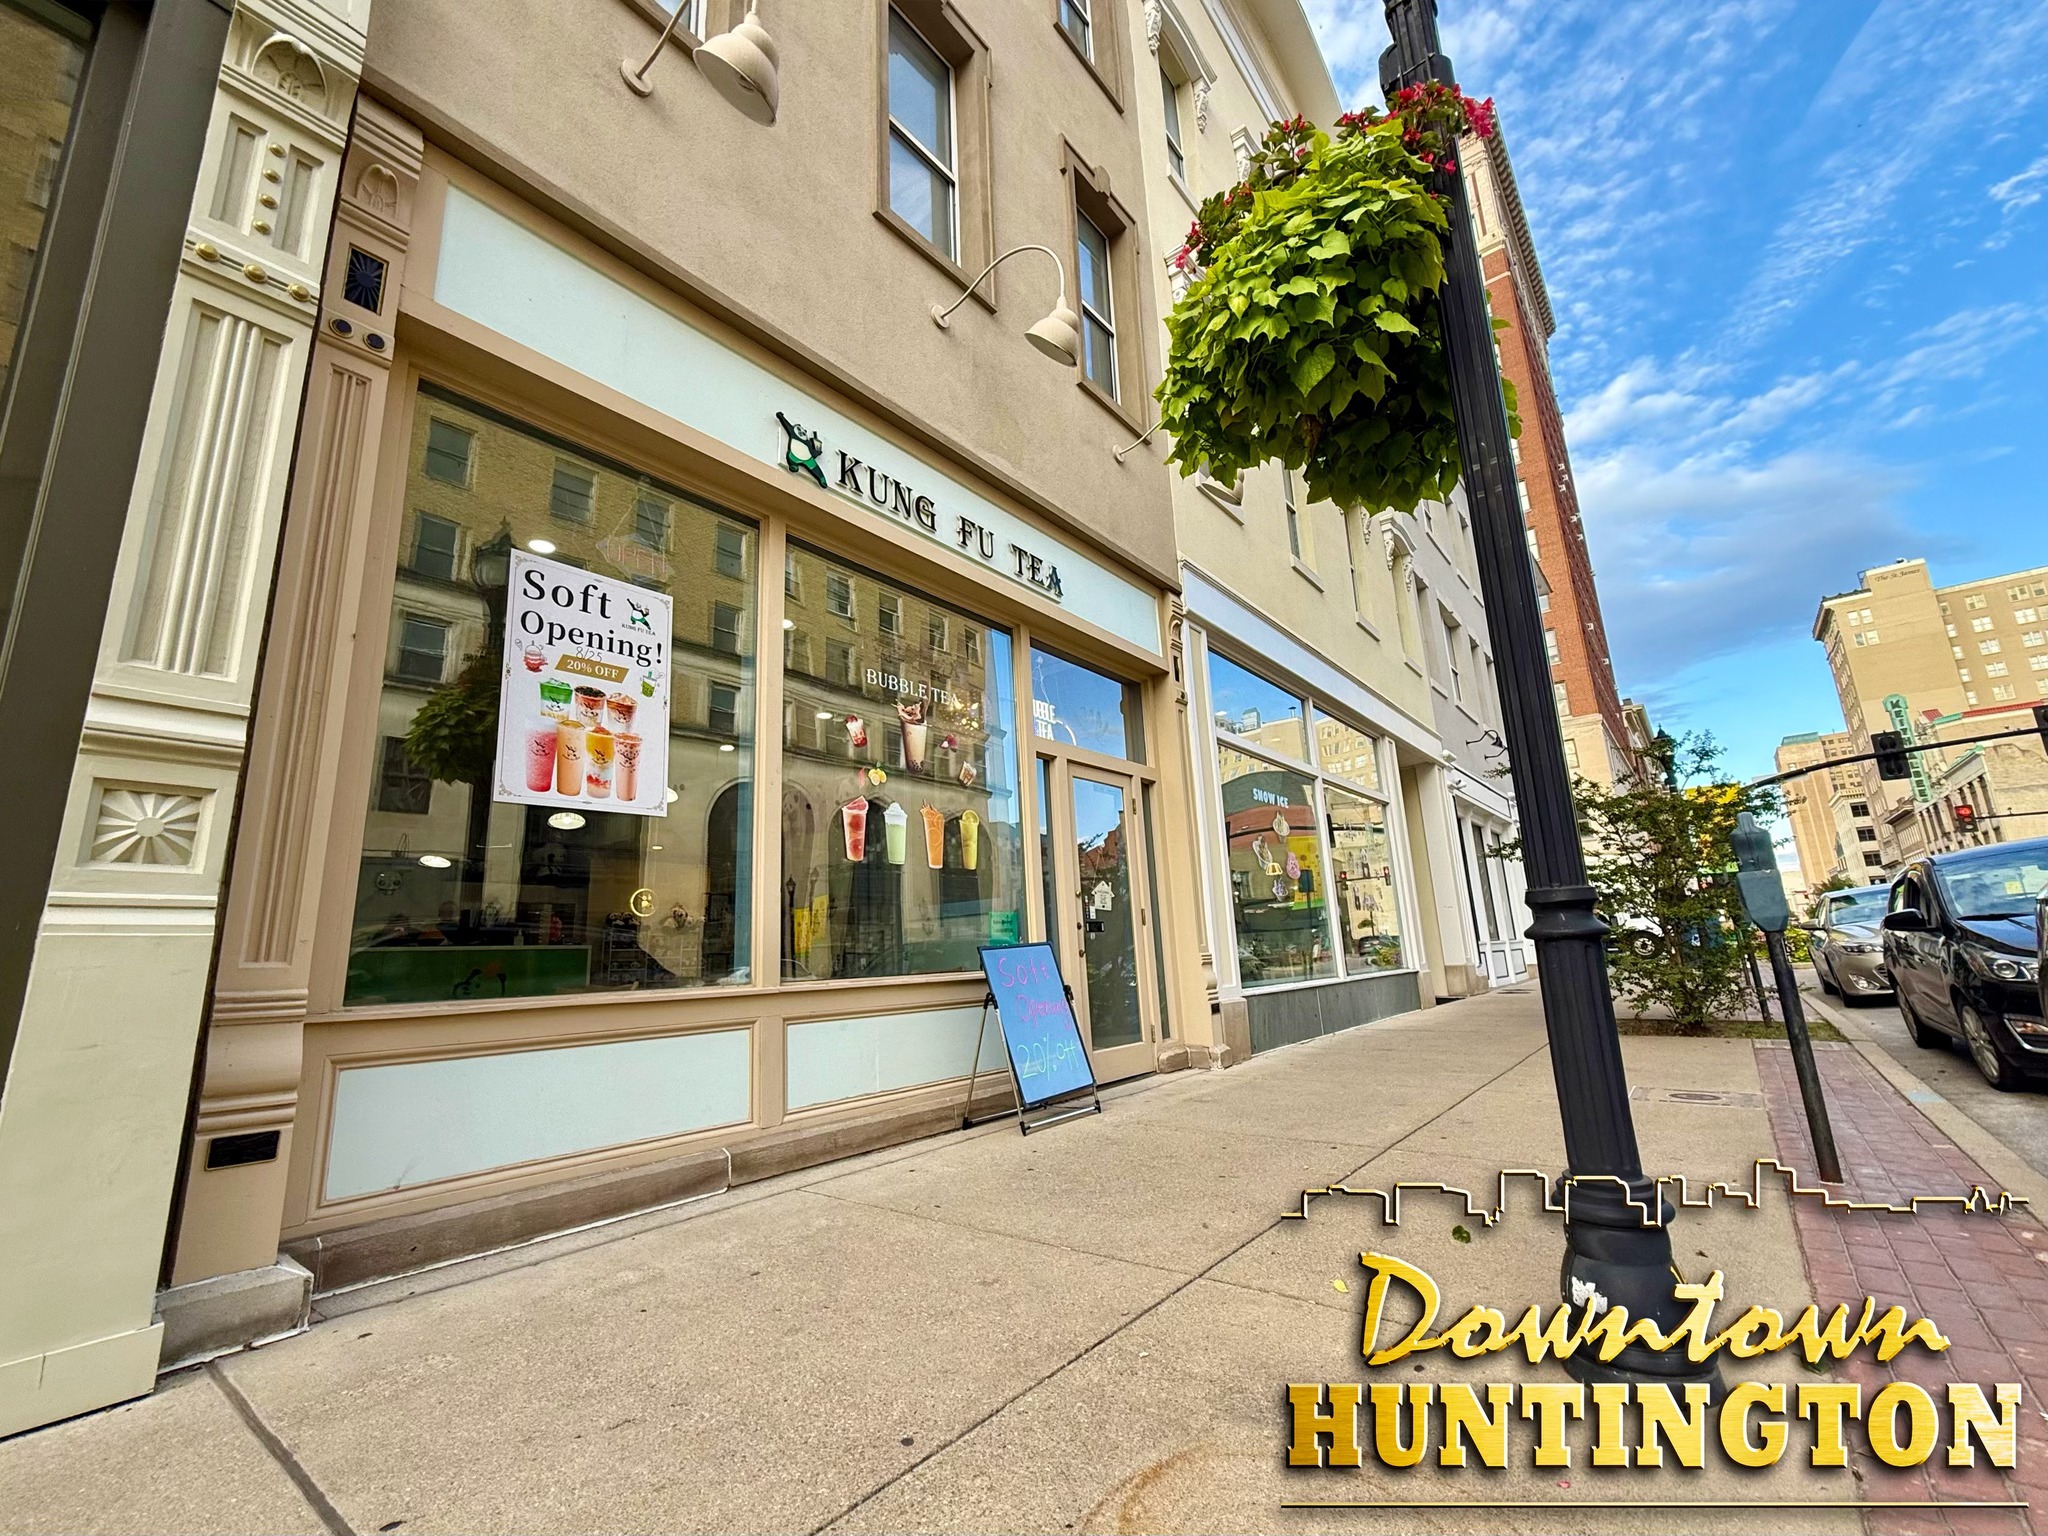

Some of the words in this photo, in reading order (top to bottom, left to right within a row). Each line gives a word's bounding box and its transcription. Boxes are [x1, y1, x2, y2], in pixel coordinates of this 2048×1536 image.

[836, 449, 937, 532] KUNG
[956, 515, 995, 560] FU
[1008, 543, 1064, 598] TEA
[1899, 569, 1920, 577] James
[523, 570, 612, 619] Soft
[520, 610, 662, 667] Opening!
[575, 646, 603, 662] 8/25
[567, 659, 592, 673] 20%
[595, 665, 619, 678] OFF
[866, 668, 928, 700] BUBBLE
[931, 687, 957, 706] TEA
[1253, 788, 1276, 805] SNOW
[1276, 795, 1289, 809] ICE
[998, 957, 1050, 987] Soft
[1016, 994, 1072, 1031] Opening
[1017, 1033, 1057, 1080] 20%
